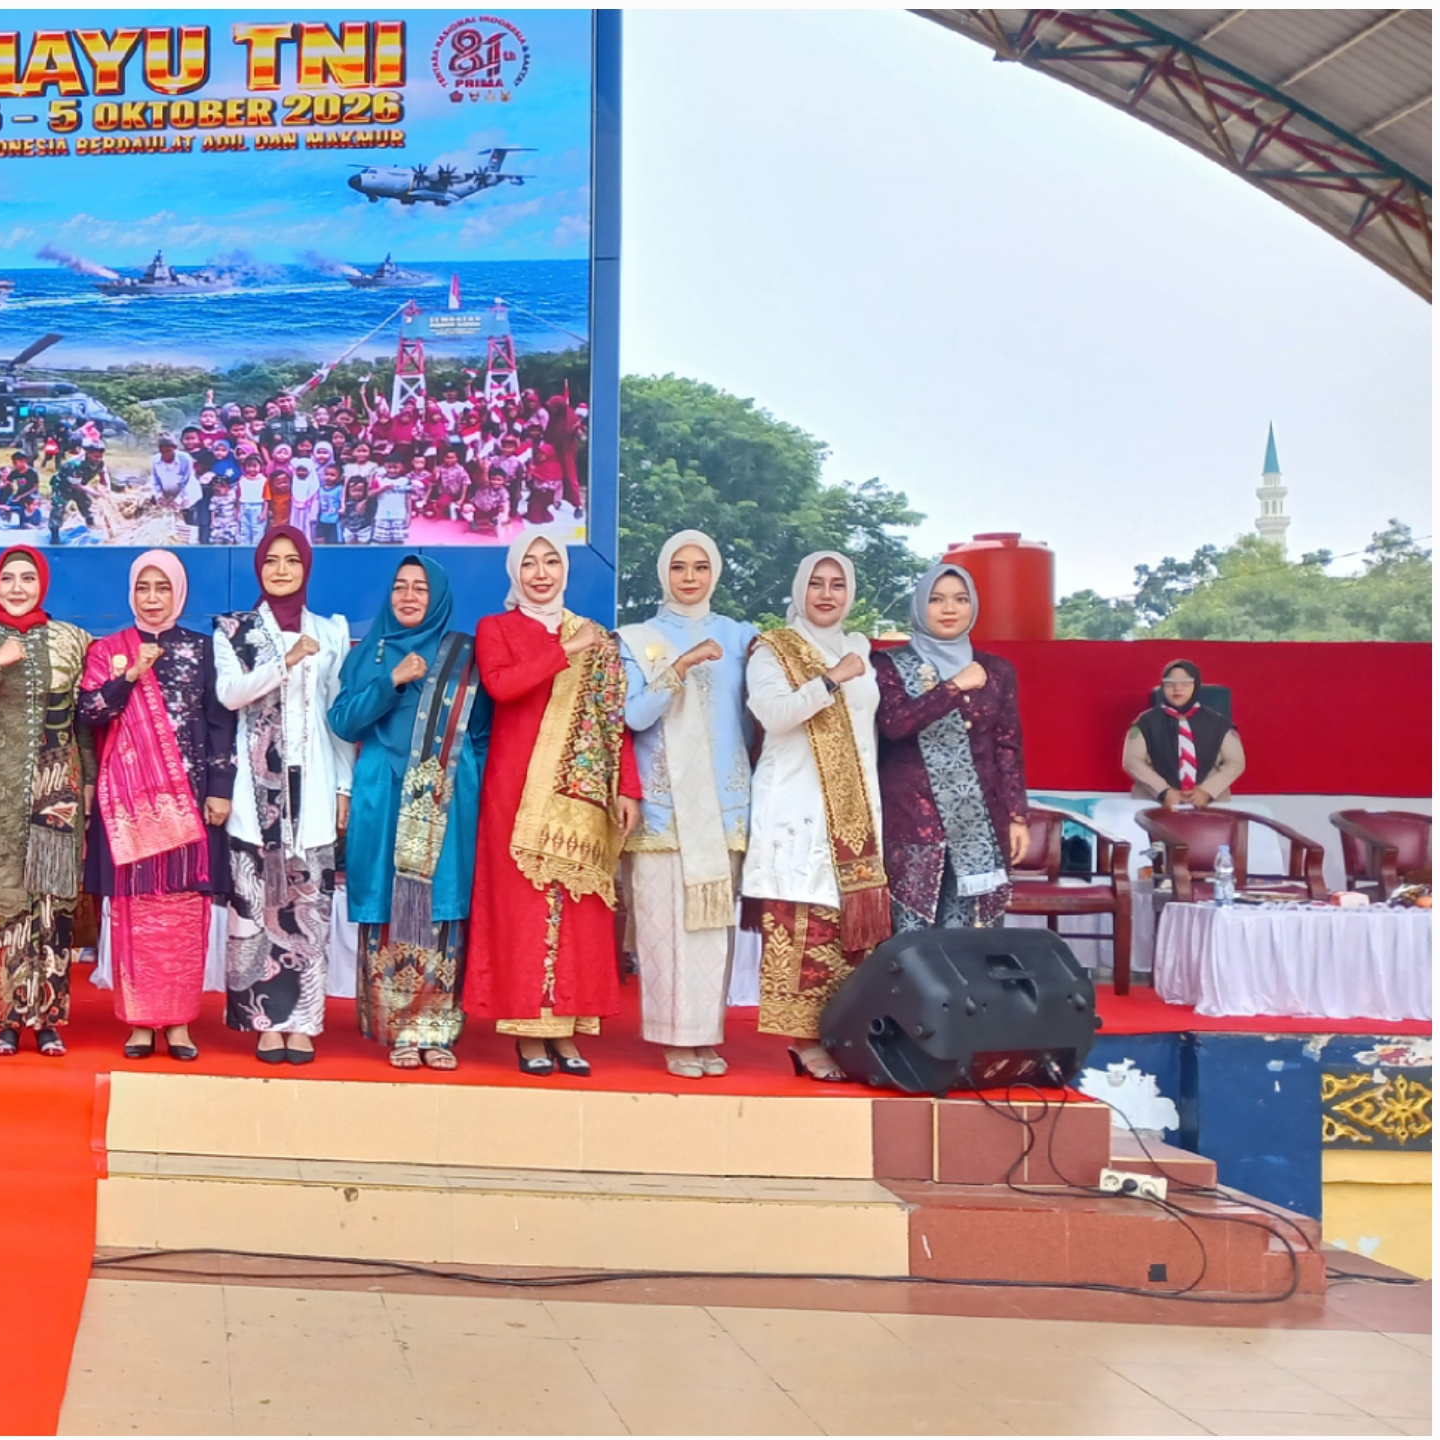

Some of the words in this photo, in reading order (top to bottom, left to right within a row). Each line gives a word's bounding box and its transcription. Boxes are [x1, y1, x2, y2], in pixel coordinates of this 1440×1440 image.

[233, 20, 406, 92] TNI
[455, 79, 504, 88] PRIMA
[48, 99, 81, 132] 5
[92, 98, 273, 131] OKTOBER
[281, 90, 404, 126] 2026
[75, 135, 196, 155] BERDAULAT
[202, 133, 248, 152] ADIL
[256, 132, 298, 150] DAN
[305, 129, 406, 149] MAKMUR
